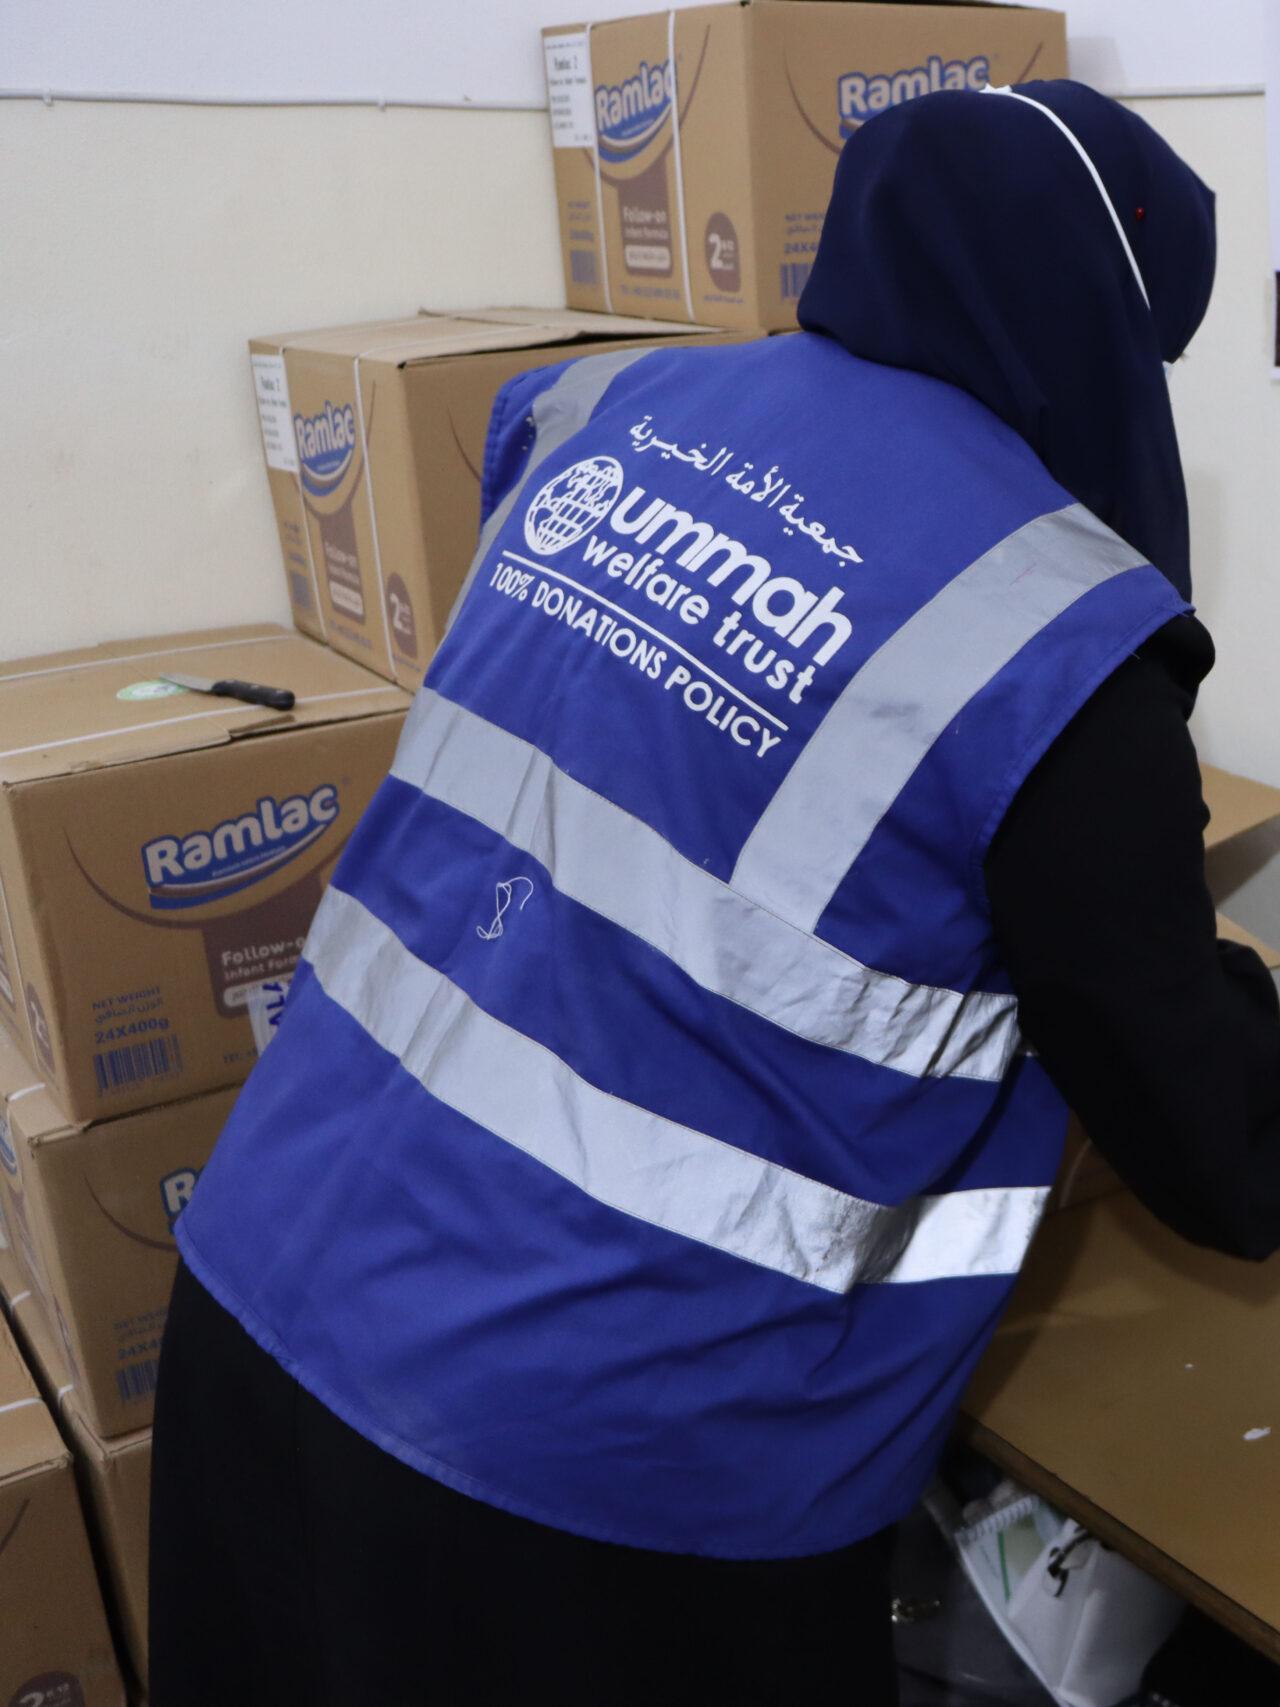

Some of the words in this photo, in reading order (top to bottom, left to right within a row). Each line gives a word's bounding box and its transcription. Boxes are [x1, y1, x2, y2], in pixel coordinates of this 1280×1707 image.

[838, 56, 989, 116] Ramlac
[294, 403, 354, 459] Ramlac
[779, 493, 864, 567] جمعية
[609, 486, 853, 667] ummah
[582, 534, 710, 626] welfare
[712, 611, 817, 704] trust
[488, 562, 533, 601] 100%
[531, 580, 669, 679] DONATIONS
[664, 664, 782, 758] POLICY
[145, 786, 337, 884] Ramlac
[221, 936, 306, 966] Follow-o
[95, 1017, 170, 1044] 24X400g
